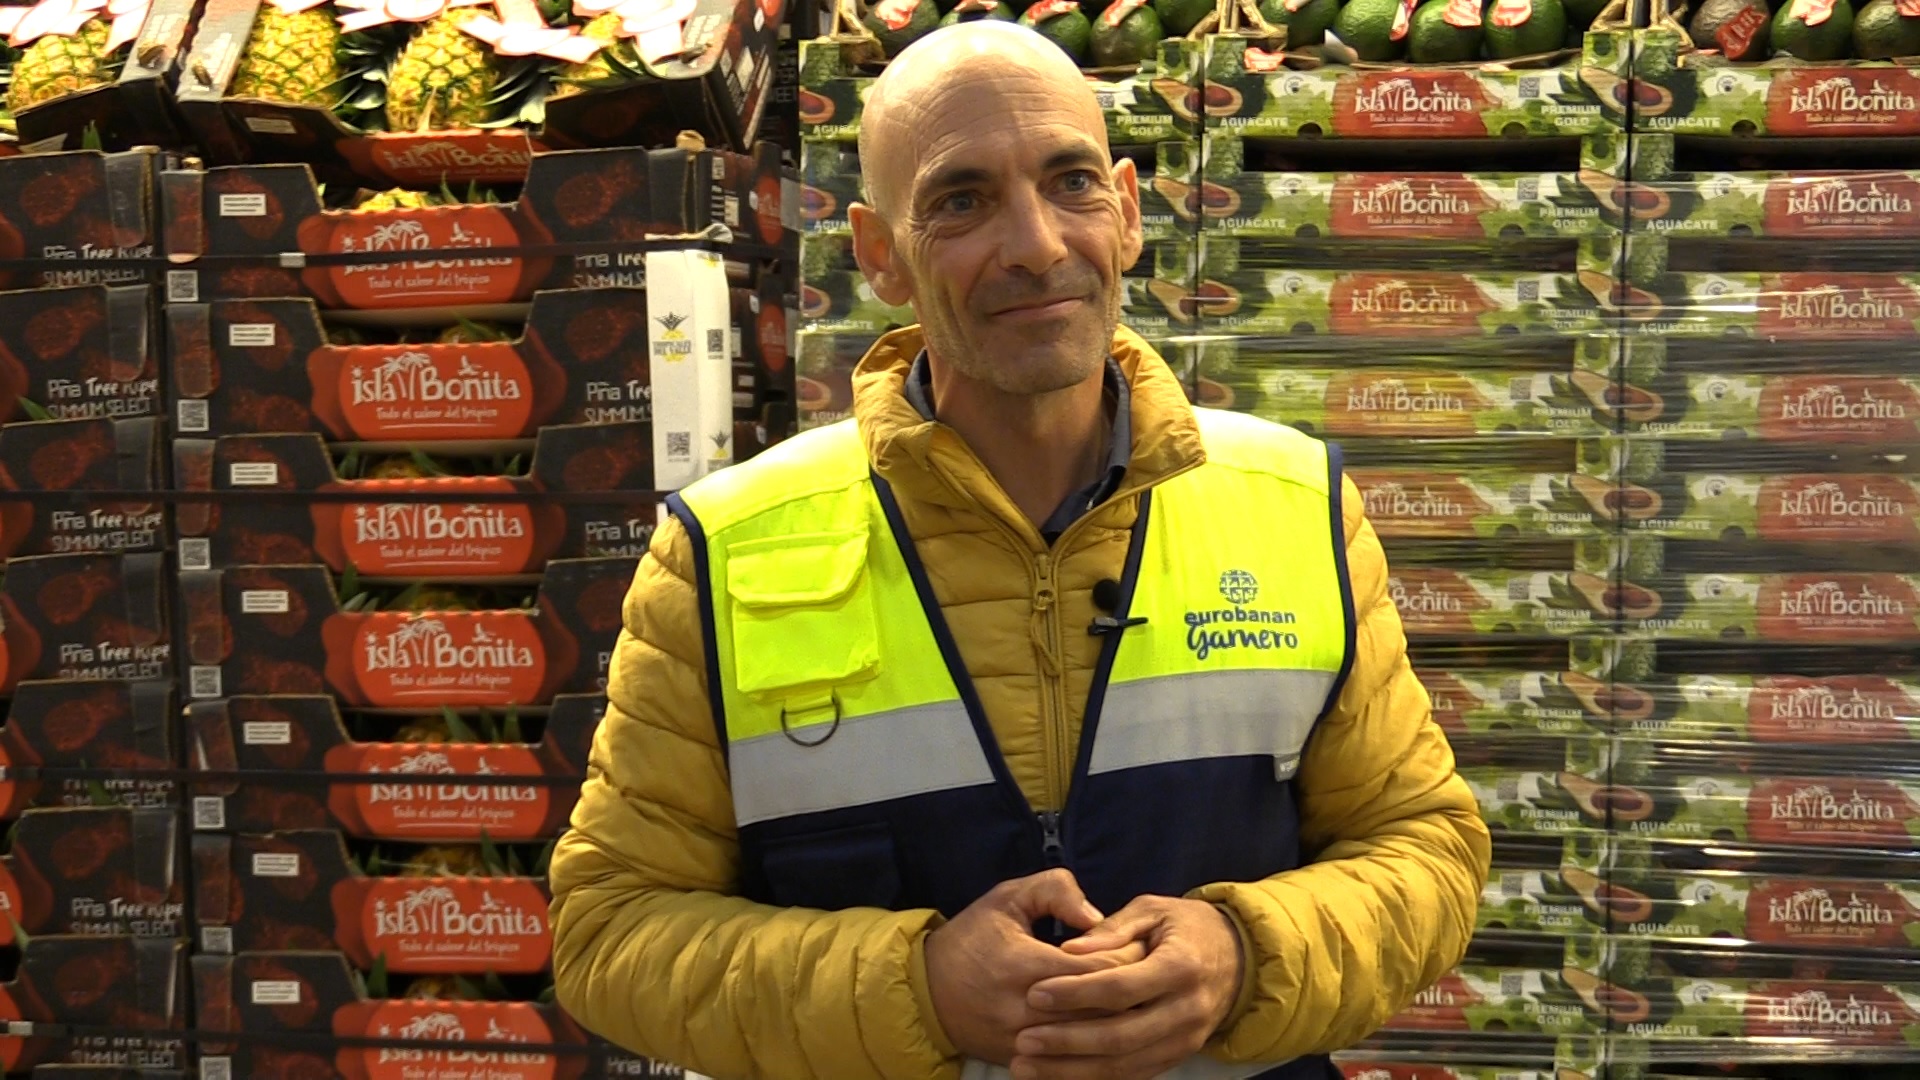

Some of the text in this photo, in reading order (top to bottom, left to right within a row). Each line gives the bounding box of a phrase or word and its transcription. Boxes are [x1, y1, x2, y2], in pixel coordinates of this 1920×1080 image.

[1354, 87, 1473, 114] isla Bonita
[1541, 105, 1601, 114] PREMIUM
[1790, 87, 1915, 113] isla Bonita
[1116, 115, 1173, 125] PREMIUM
[1219, 117, 1289, 127] AGUACATE
[1554, 117, 1590, 126] GOLD
[1648, 117, 1721, 128] AGUACATE
[1129, 126, 1163, 136] GOLD
[1352, 190, 1470, 215] isla Bonita
[1539, 207, 1599, 217] PREMIUM
[1786, 189, 1912, 216] isla Bonita
[1142, 215, 1174, 224] MIUM
[1218, 219, 1287, 229] AGUACATE
[1552, 219, 1589, 229] GOLD
[1646, 219, 1718, 230] AGUACATE
[368, 277, 391, 288] Todo
[394, 276, 403, 287] el
[437, 273, 450, 285] del
[1830, 295, 1904, 319] Bonita
[85, 376, 119, 397] Tree
[352, 365, 521, 406] isla Bonita
[587, 379, 651, 401] Piña Tre
[1394, 387, 1463, 412] Bonita
[1781, 394, 1906, 420] isla Bonita
[376, 407, 400, 420] Todo
[1393, 490, 1463, 516] Bonita
[1780, 491, 1904, 516] isla Bonita
[90, 508, 124, 528] Tree
[355, 504, 524, 544] isla Bonita
[1532, 512, 1592, 522] PREMIUM
[585, 521, 621, 541] Piña
[1531, 609, 1591, 618] PREMIUM
[1780, 591, 1904, 616] isla Bonita
[1184, 606, 1296, 626] eurobanan
[97, 641, 131, 661] Tree
[365, 632, 534, 672] isla Bonita
[1771, 695, 1895, 720] isla Bonita
[1520, 809, 1579, 819] PREMIUM
[1771, 794, 1895, 820] isla Bonita
[1630, 821, 1700, 832] AGUACATE
[109, 896, 144, 917] Tree
[1524, 905, 1584, 914] PREMIUM
[1768, 897, 1893, 923] isla Bonita
[375, 898, 542, 937] isla Bonita
[1537, 916, 1572, 926] GOLD
[1628, 923, 1699, 934] AGUACATE
[1415, 984, 1454, 1006] nita
[1523, 1004, 1583, 1014] PREMIUM
[1818, 999, 1892, 1025] Bonita
[1536, 1015, 1572, 1025] GOLD
[1626, 1023, 1698, 1034] AGUACATE
